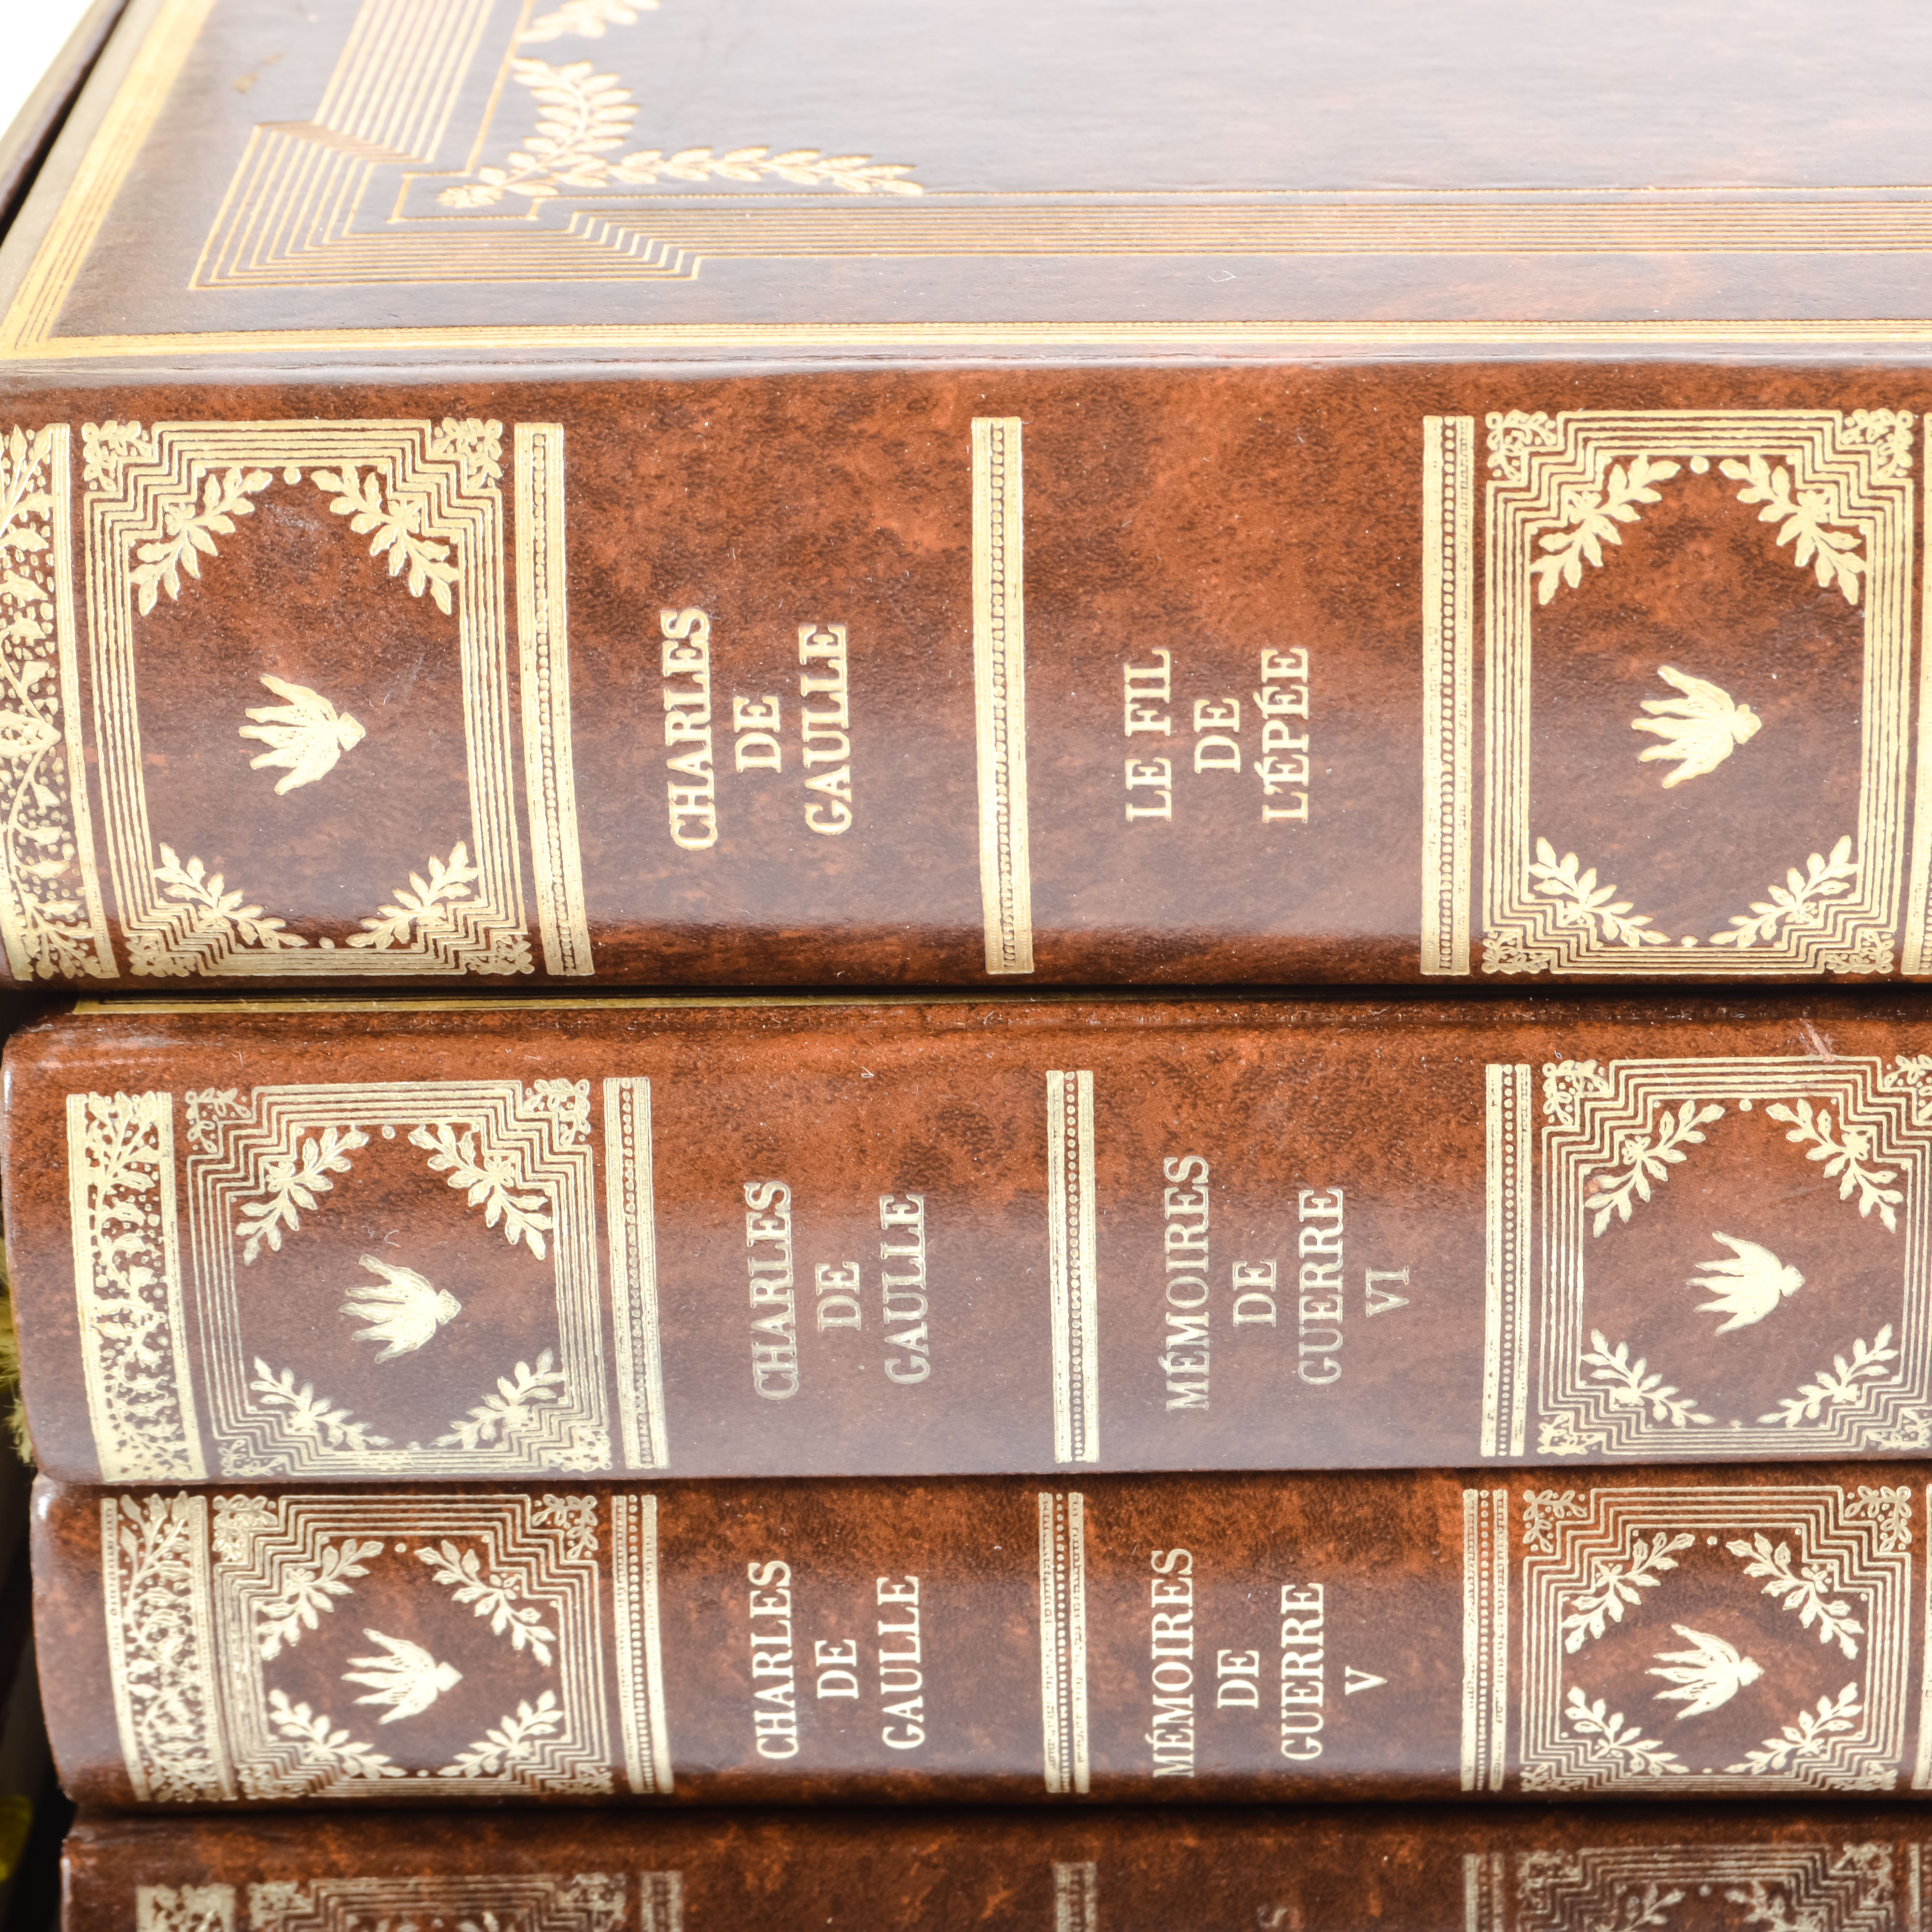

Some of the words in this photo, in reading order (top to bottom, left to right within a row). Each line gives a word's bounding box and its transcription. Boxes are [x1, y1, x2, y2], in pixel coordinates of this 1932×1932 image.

[661, 607, 718, 851] CHARLES
[734, 694, 781, 773] DE
[798, 623, 853, 836] GAULLE
[1123, 647, 1171, 737] FIL
[1194, 697, 1241, 774] DE
[1254, 647, 1310, 823] L'ÉPÉE
[1125, 756, 1172, 823] LE
[744, 1179, 800, 1400] CHARLES
[815, 1261, 862, 1331] DE
[879, 1193, 930, 1384] GAULLE
[1158, 1154, 1210, 1411] MÉMOIRES
[1232, 1258, 1277, 1327] DE
[1297, 1187, 1345, 1386] GUERRE
[1365, 1265, 1410, 1317] VI
[747, 1559, 799, 1761] CHARLES
[815, 1638, 859, 1700] DE
[876, 1574, 925, 1750] GAULLE
[1145, 1548, 1195, 1778] MÉMOIRES
[1217, 1648, 1260, 1709] DE
[1280, 1582, 1324, 1761] GUERRE
[1344, 1665, 1388, 1696] V
